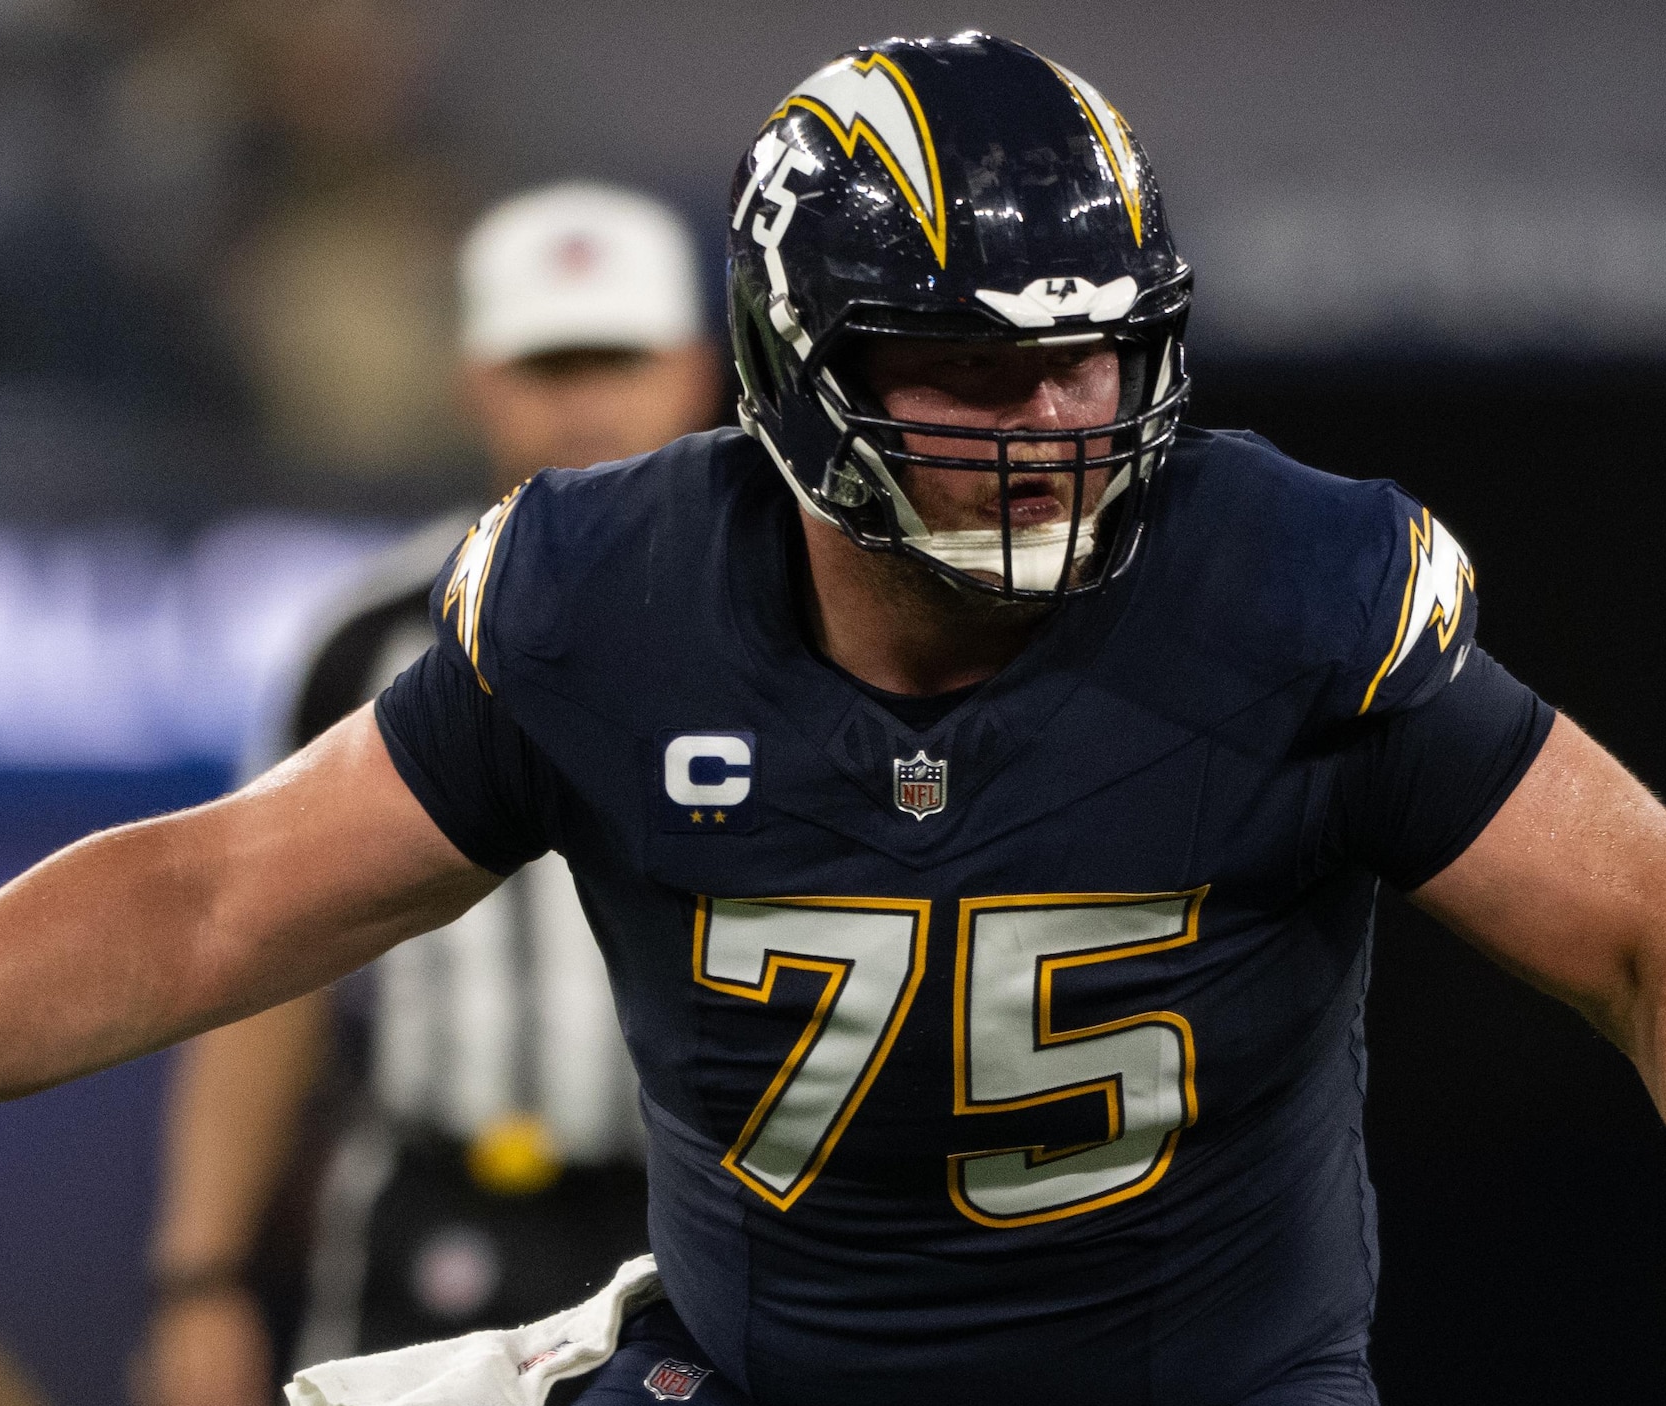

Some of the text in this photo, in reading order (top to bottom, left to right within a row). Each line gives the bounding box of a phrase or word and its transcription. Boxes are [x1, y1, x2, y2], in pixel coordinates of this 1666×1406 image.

[732, 131, 817, 248] 75
[1046, 279, 1077, 304] LA
[664, 735, 751, 806] C
[902, 784, 938, 808] NFL
[693, 884, 1211, 1228] 75
[653, 1369, 688, 1393] NFL
